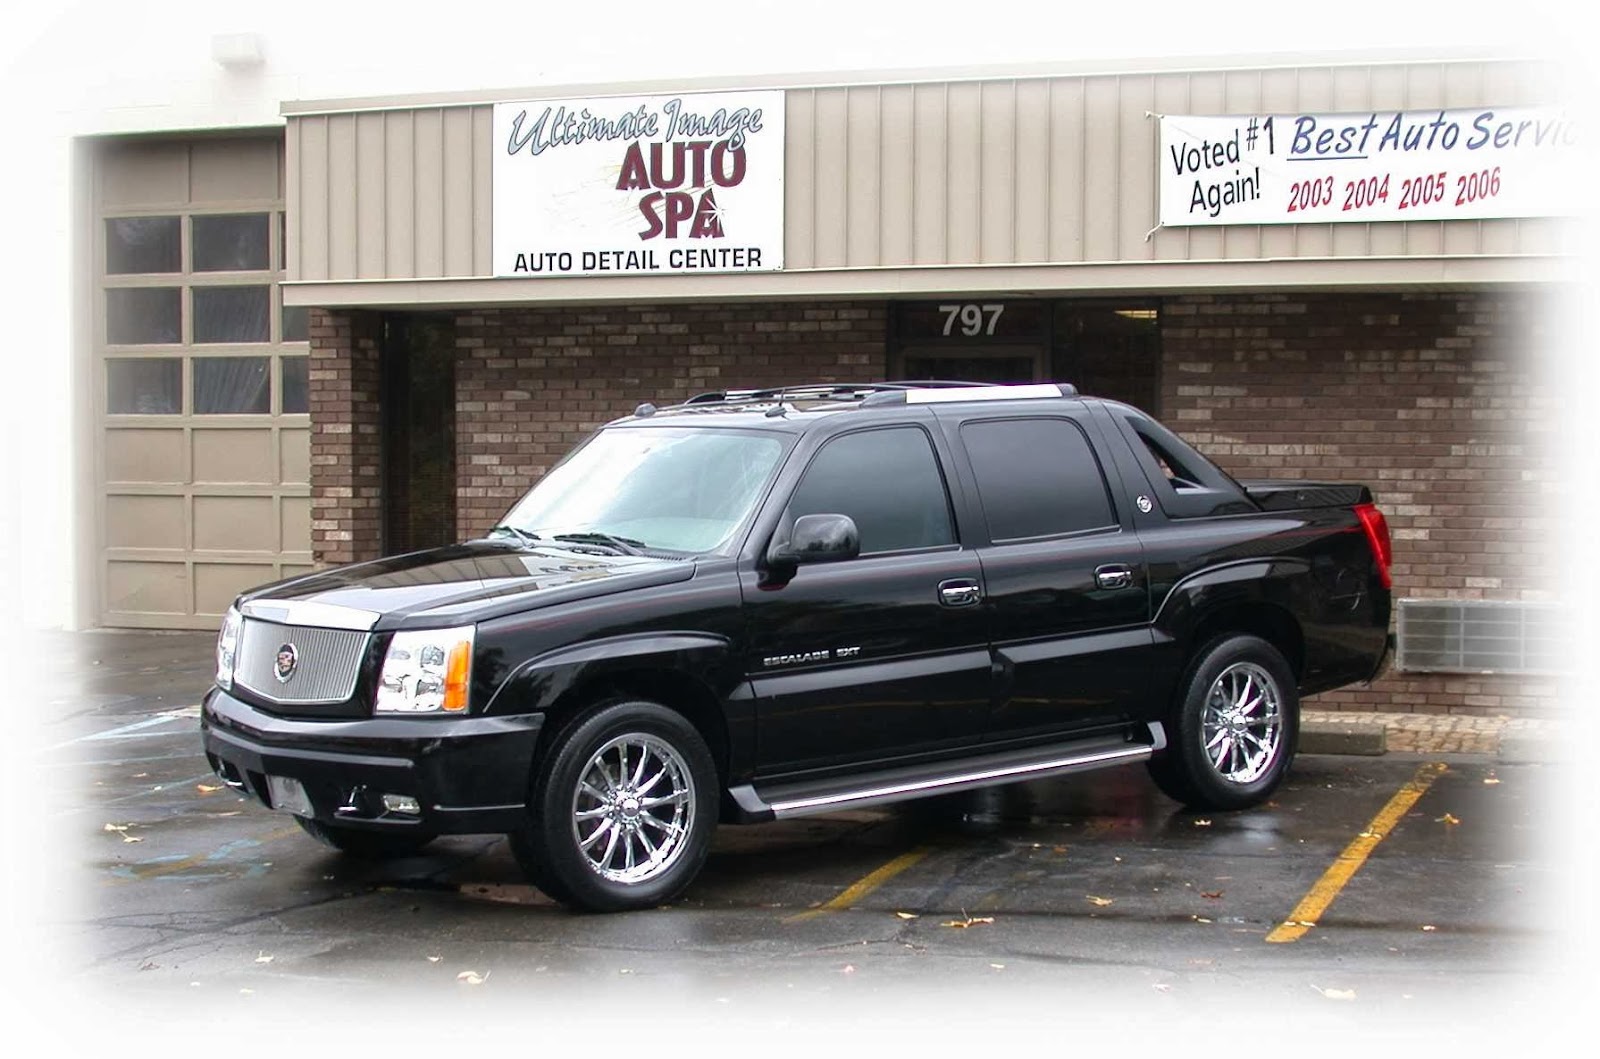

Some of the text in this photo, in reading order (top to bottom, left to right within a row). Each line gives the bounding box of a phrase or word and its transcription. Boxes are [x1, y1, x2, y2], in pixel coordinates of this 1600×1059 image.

[507, 98, 763, 156] Ultimate Image
[1171, 116, 1275, 175] Voted #1
[1290, 115, 1379, 155] Best
[1379, 109, 1461, 152] Auto
[615, 139, 747, 190] AUTO
[638, 187, 725, 241] SPA
[1189, 166, 1261, 218] Again!
[1287, 166, 1501, 213] 2003 2004 2005 2006
[513, 247, 762, 272] AUTO DETAIL CENTER
[938, 304, 1004, 336] 797
[763, 646, 861, 666] ESCALADE EXT
